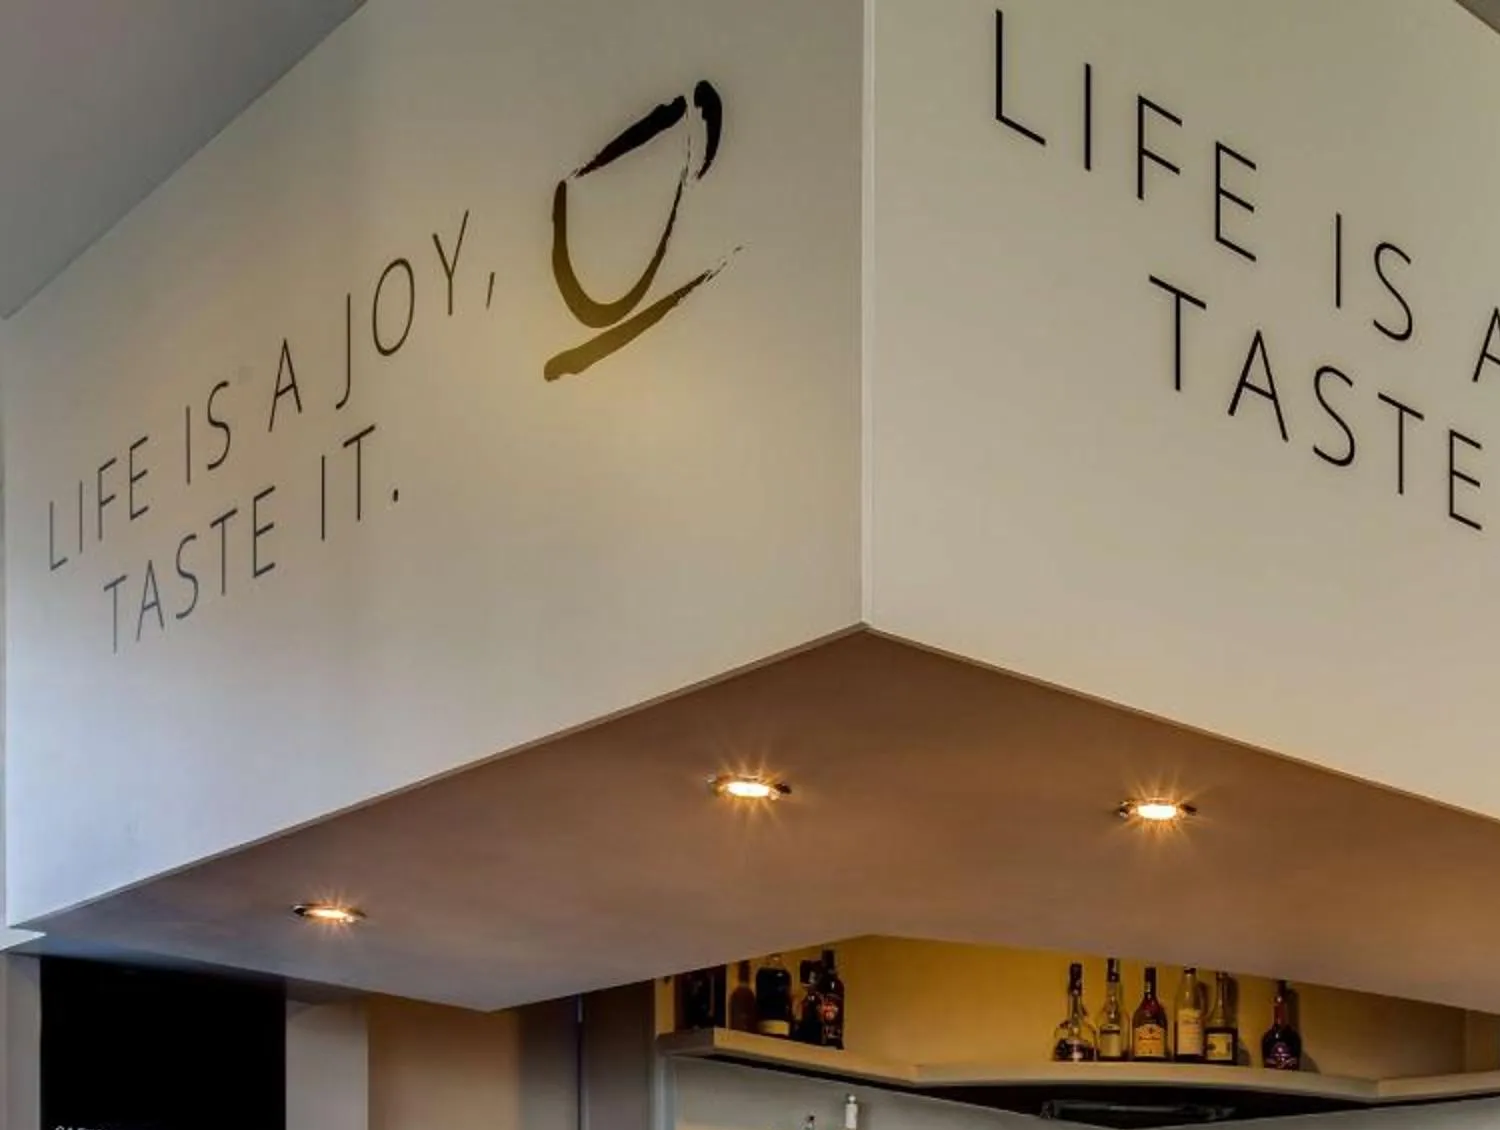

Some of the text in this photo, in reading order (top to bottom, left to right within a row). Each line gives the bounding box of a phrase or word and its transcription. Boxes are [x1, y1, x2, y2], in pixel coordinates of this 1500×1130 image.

[995, 8, 1257, 263] LIFE
[1335, 211, 1414, 344] IS
[49, 209, 496, 571] LIFE IS A JOY,
[103, 423, 399, 654] TASTE IT.
[1148, 274, 1483, 532] TASTE
